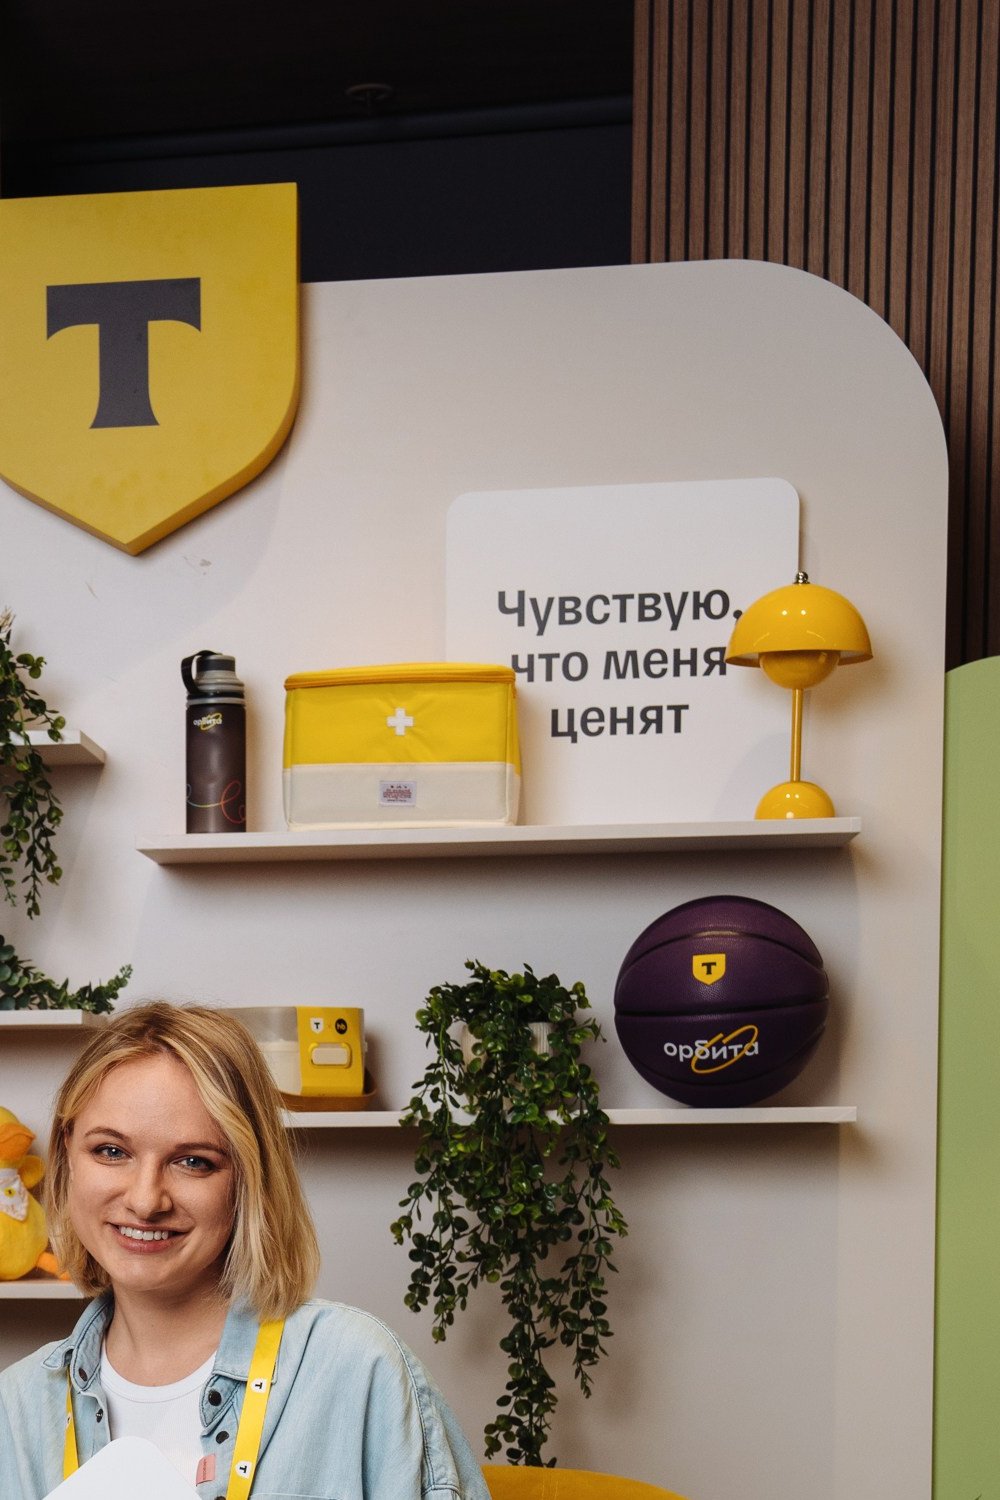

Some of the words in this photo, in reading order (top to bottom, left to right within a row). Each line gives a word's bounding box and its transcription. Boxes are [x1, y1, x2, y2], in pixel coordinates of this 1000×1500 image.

[46, 277, 202, 430] Т
[511, 651, 588, 683] что
[603, 646, 727, 680] меня
[550, 704, 690, 744] ценят
[663, 1038, 759, 1064] орбита
